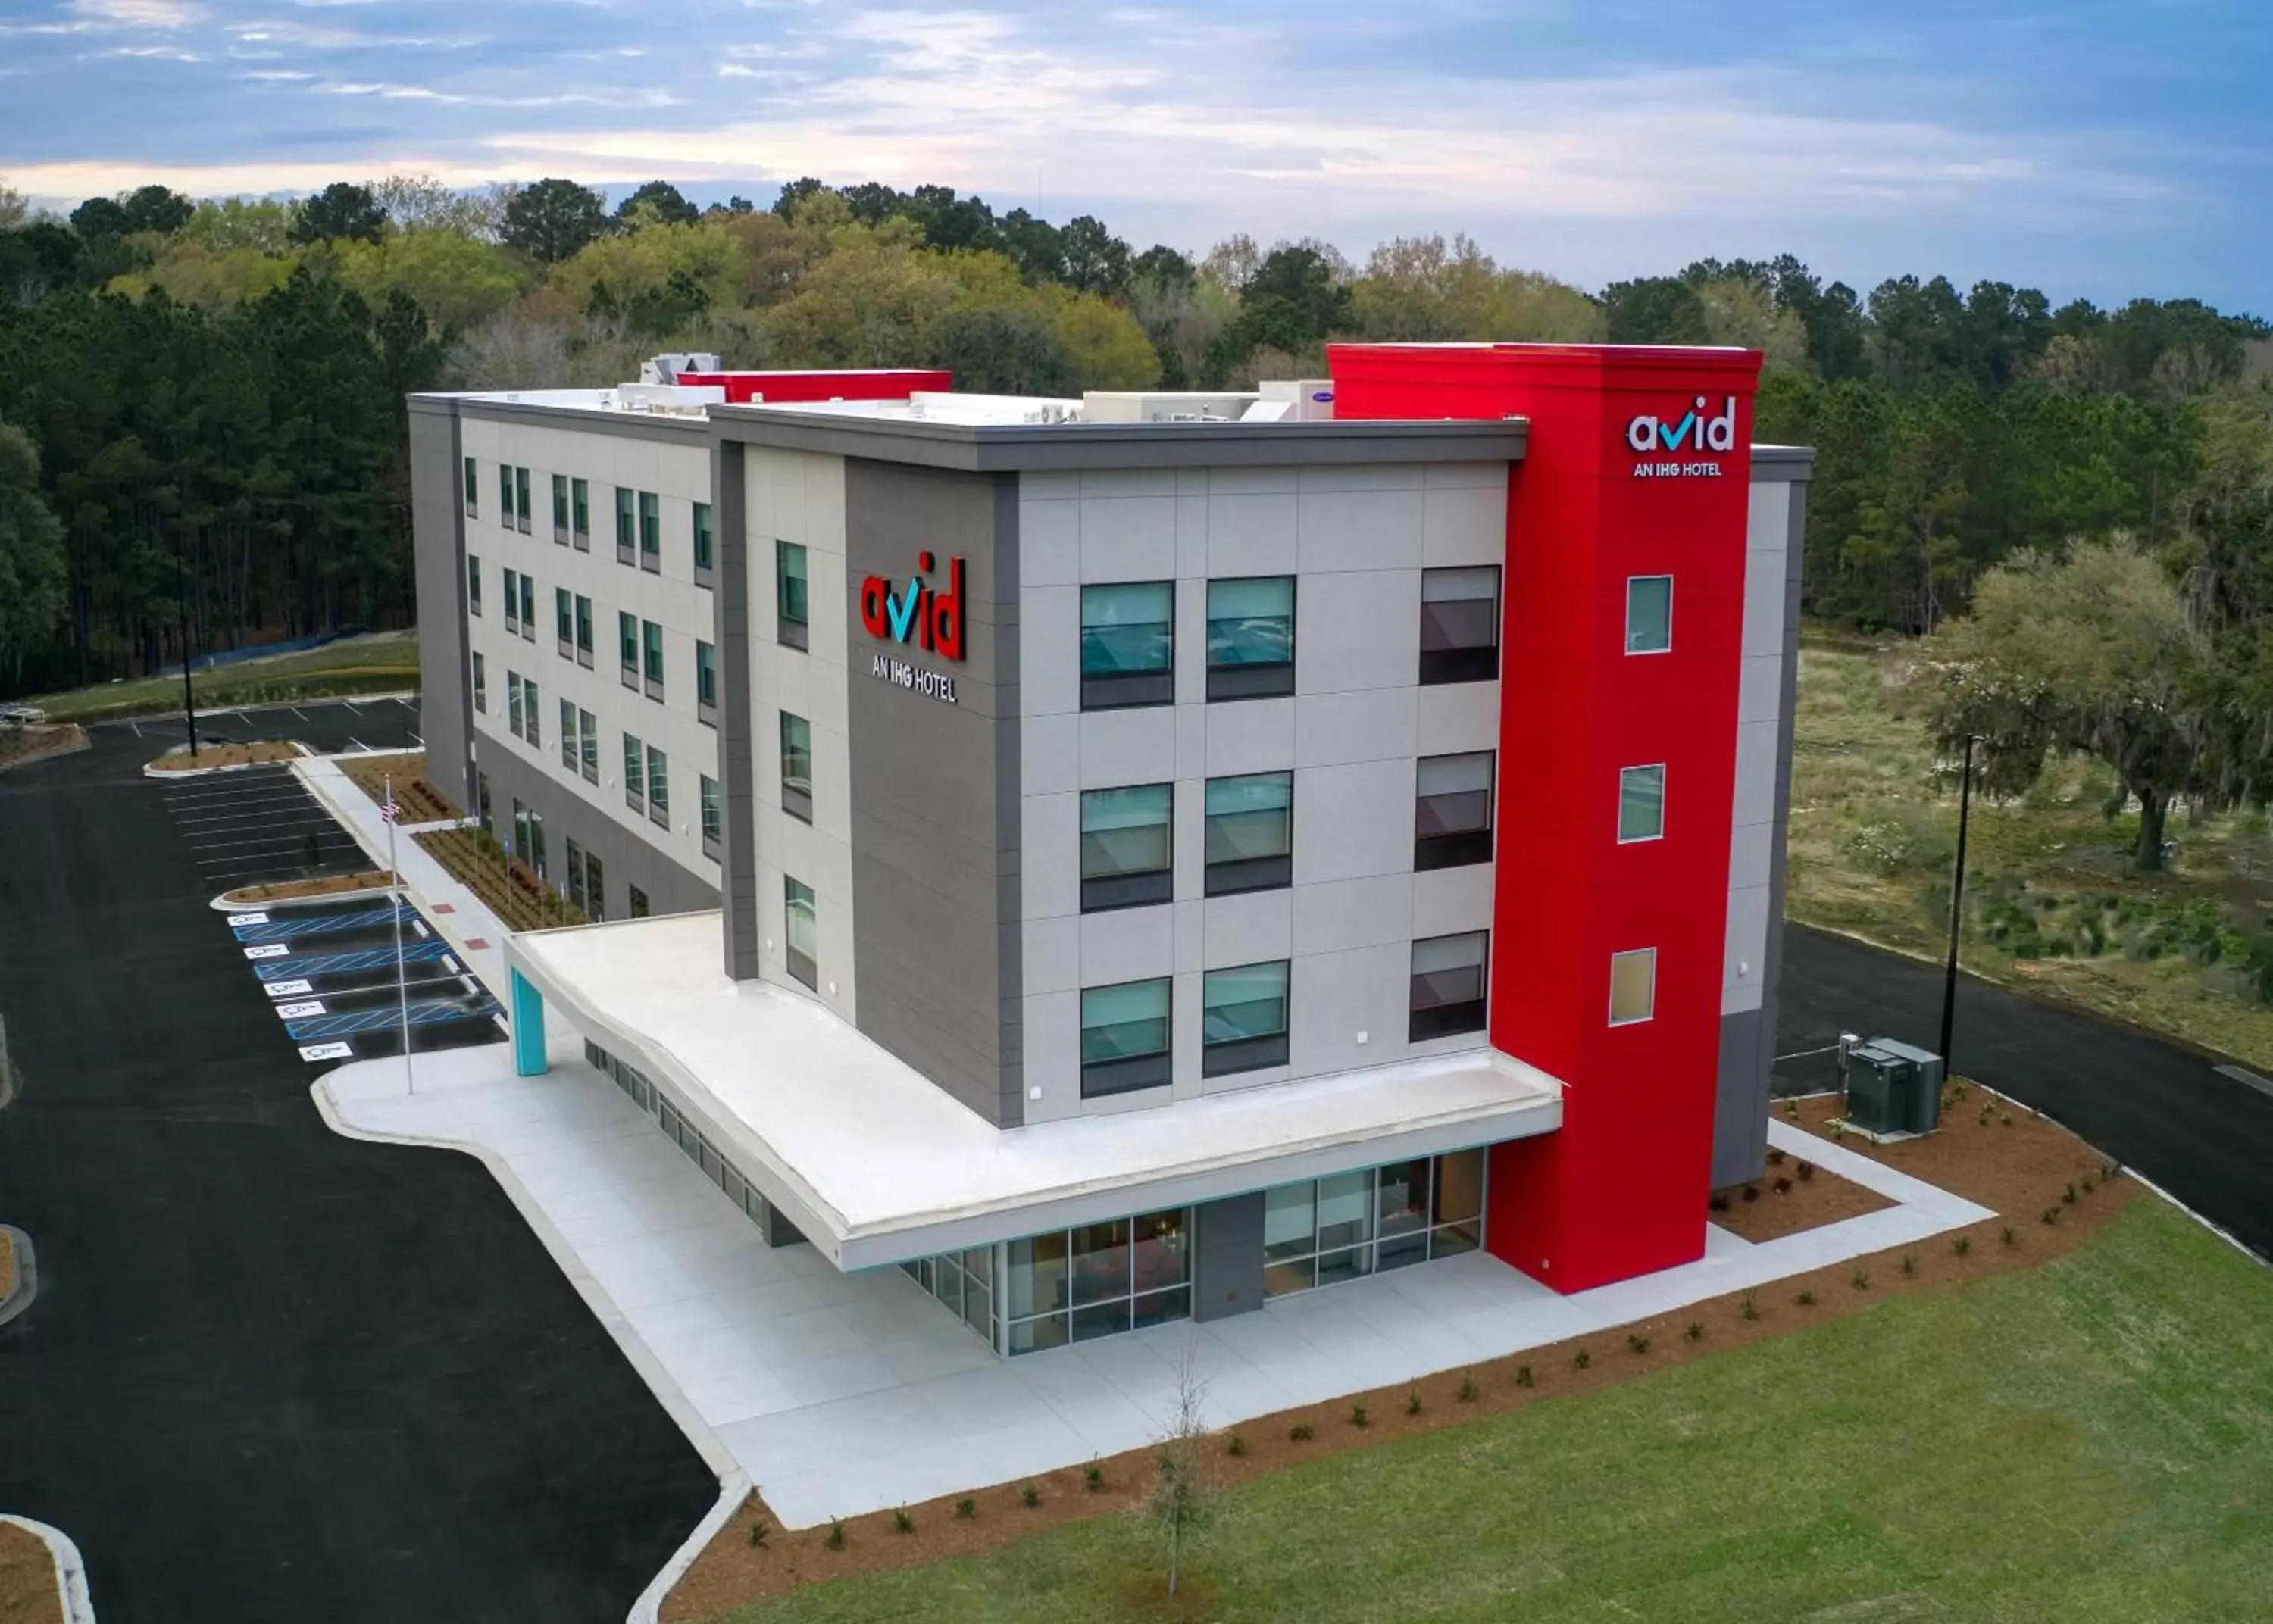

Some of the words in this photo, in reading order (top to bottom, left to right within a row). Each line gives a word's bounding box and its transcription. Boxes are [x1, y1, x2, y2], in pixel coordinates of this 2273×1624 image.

[1628, 395, 1737, 451] avid
[1634, 463, 1653, 477] AN
[1656, 463, 1680, 477] IHG
[1682, 462, 1722, 476] HOTEL
[860, 550, 967, 661] avid
[872, 654, 890, 679] AN
[890, 661, 913, 689] IHG
[915, 668, 957, 703] HOTEL
